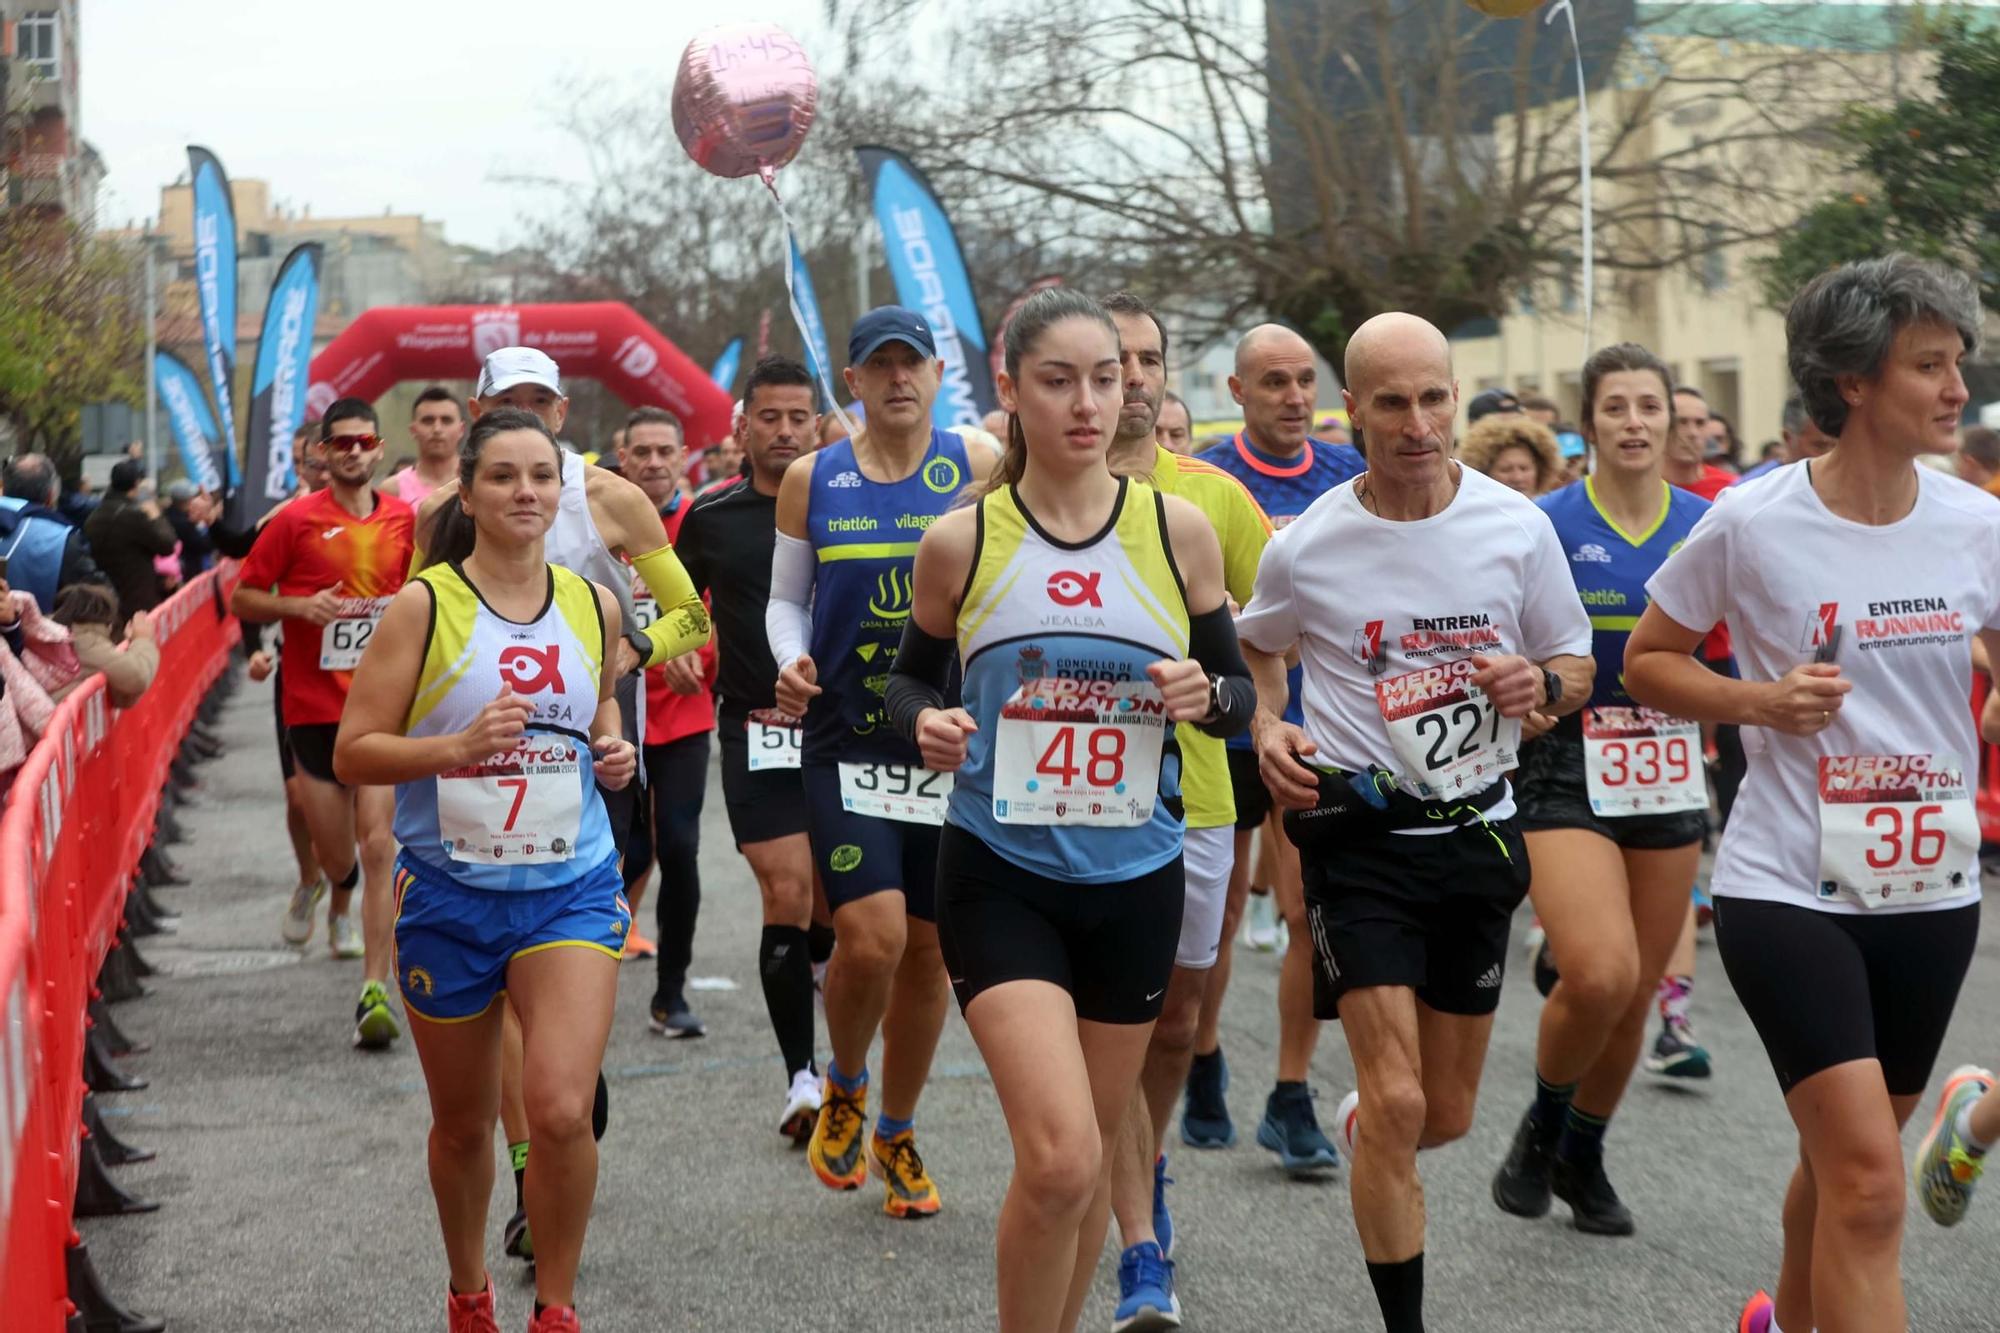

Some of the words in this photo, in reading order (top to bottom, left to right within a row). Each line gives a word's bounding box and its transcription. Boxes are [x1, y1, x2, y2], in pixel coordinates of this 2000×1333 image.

[828, 515, 878, 532] triatlón
[1868, 597, 1947, 617] ENTRENA
[1041, 615, 1106, 628] JEALSA
[1413, 613, 1490, 631] ENTRENA
[1855, 611, 1964, 639] RUNNING
[1858, 633, 1964, 651] entrenarunning.com
[1056, 658, 1114, 670] CONCELLO
[1119, 662, 1133, 671] DE
[1382, 660, 1474, 697] MEDIO
[1415, 702, 1500, 771] 227
[1036, 726, 1127, 787] 48
[1601, 738, 1691, 787] 339
[1826, 756, 1932, 774] MEDIO
[854, 764, 943, 798] 392
[1827, 768, 1963, 791] MARATÓN
[497, 778, 528, 832] 7
[1865, 805, 1947, 869] 36
